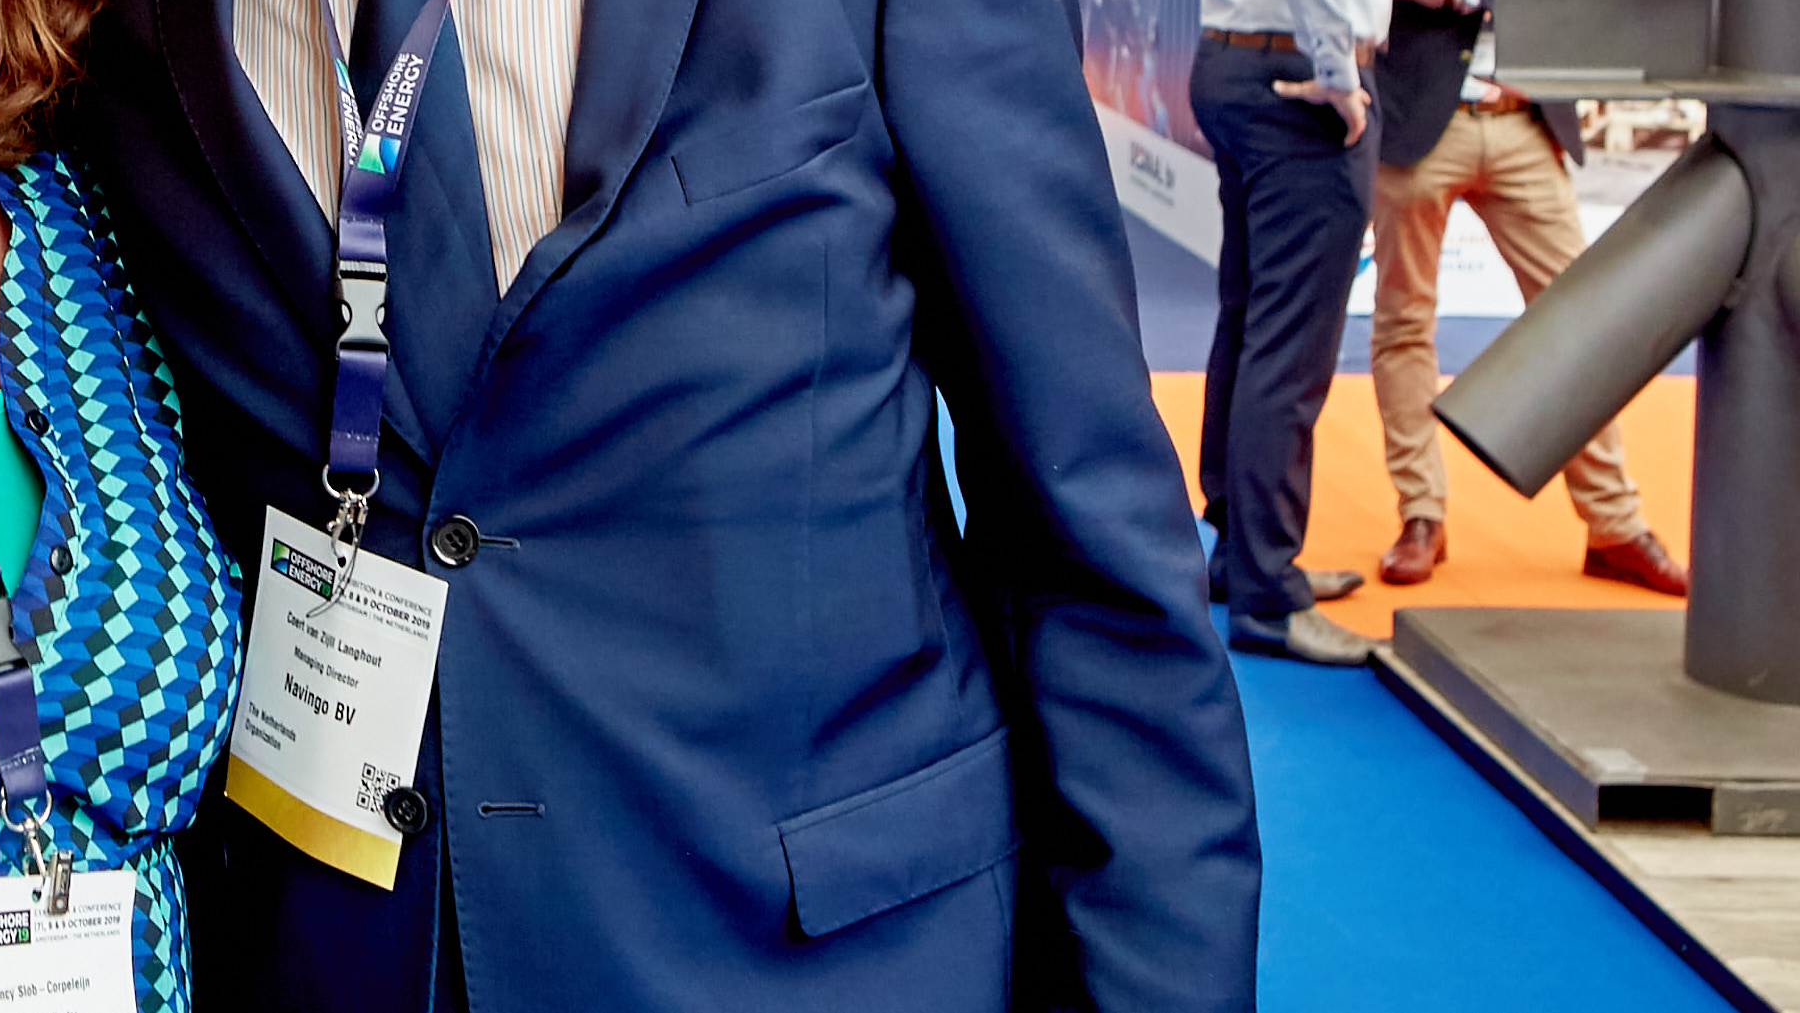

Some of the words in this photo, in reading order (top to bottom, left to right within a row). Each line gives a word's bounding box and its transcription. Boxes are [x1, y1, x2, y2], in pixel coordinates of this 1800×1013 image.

[372, 53, 410, 132] OFFSHORE
[386, 54, 424, 136] ENERGY
[289, 551, 334, 584] OFFSHORE
[370, 600, 410, 622] OCTOBER
[411, 615, 431, 630] 2019
[384, 591, 432, 616] CONFERENCE
[287, 610, 305, 632] Coert
[306, 622, 319, 639] van
[338, 639, 382, 668] Langhout
[294, 645, 325, 676] Managing
[326, 664, 359, 689] Director
[284, 673, 329, 715] Navingo
[334, 702, 356, 726] BV
[245, 718, 282, 751] Organization
[248, 701, 259, 718] The
[261, 711, 297, 743] Netherlands
[67, 916, 102, 929] OCTOBER
[104, 915, 121, 925] 2019
[78, 903, 121, 913] CONFERENCE
[17, 984, 38, 998] Slob
[46, 977, 91, 994] Corpeleijn
